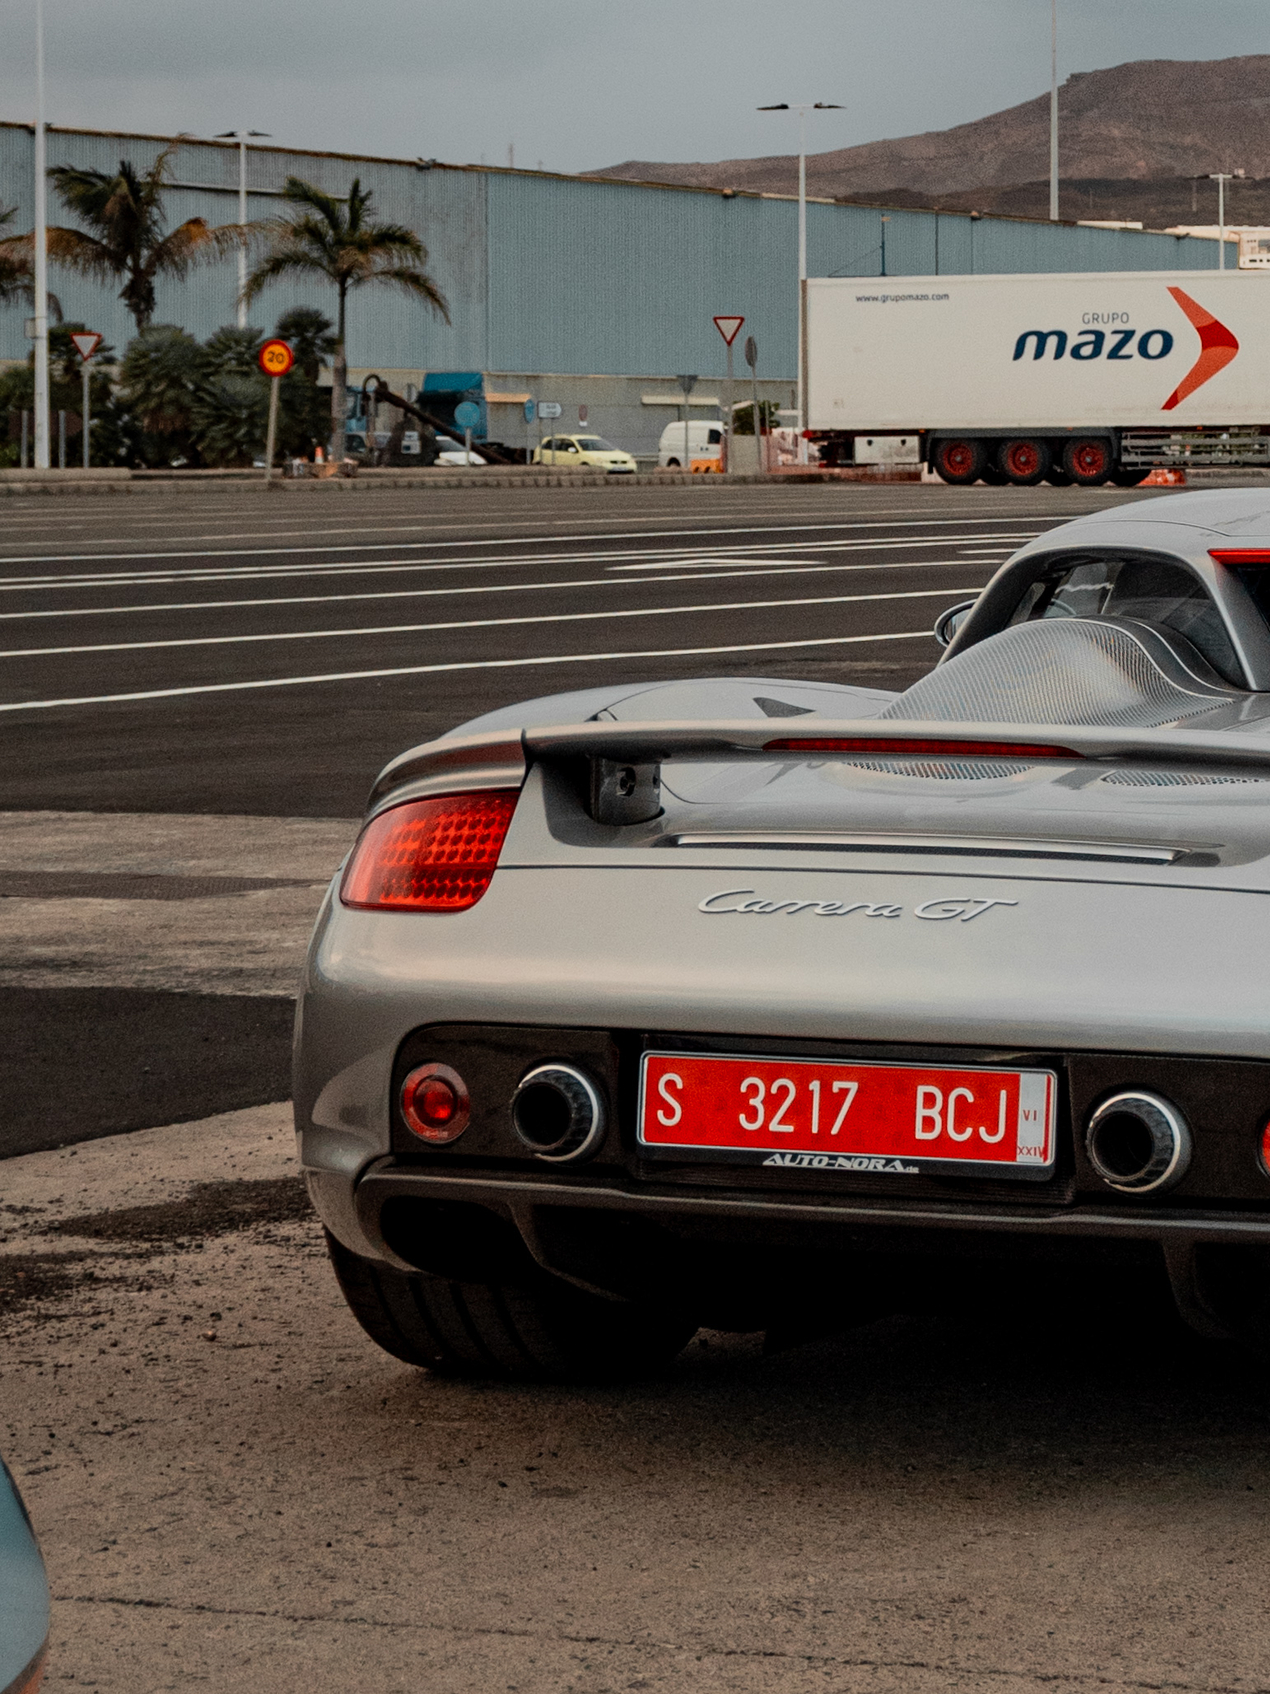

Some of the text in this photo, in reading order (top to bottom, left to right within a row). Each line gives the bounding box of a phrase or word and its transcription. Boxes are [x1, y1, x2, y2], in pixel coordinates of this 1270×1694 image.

[855, 293, 950, 304] www.grupomazo.com
[1082, 312, 1130, 325] GRUPO
[1012, 329, 1174, 361] mazo
[698, 889, 1019, 921] Carrera GT
[656, 1072, 1007, 1144] S 3217 BCJ
[1022, 1109, 1037, 1121] VI
